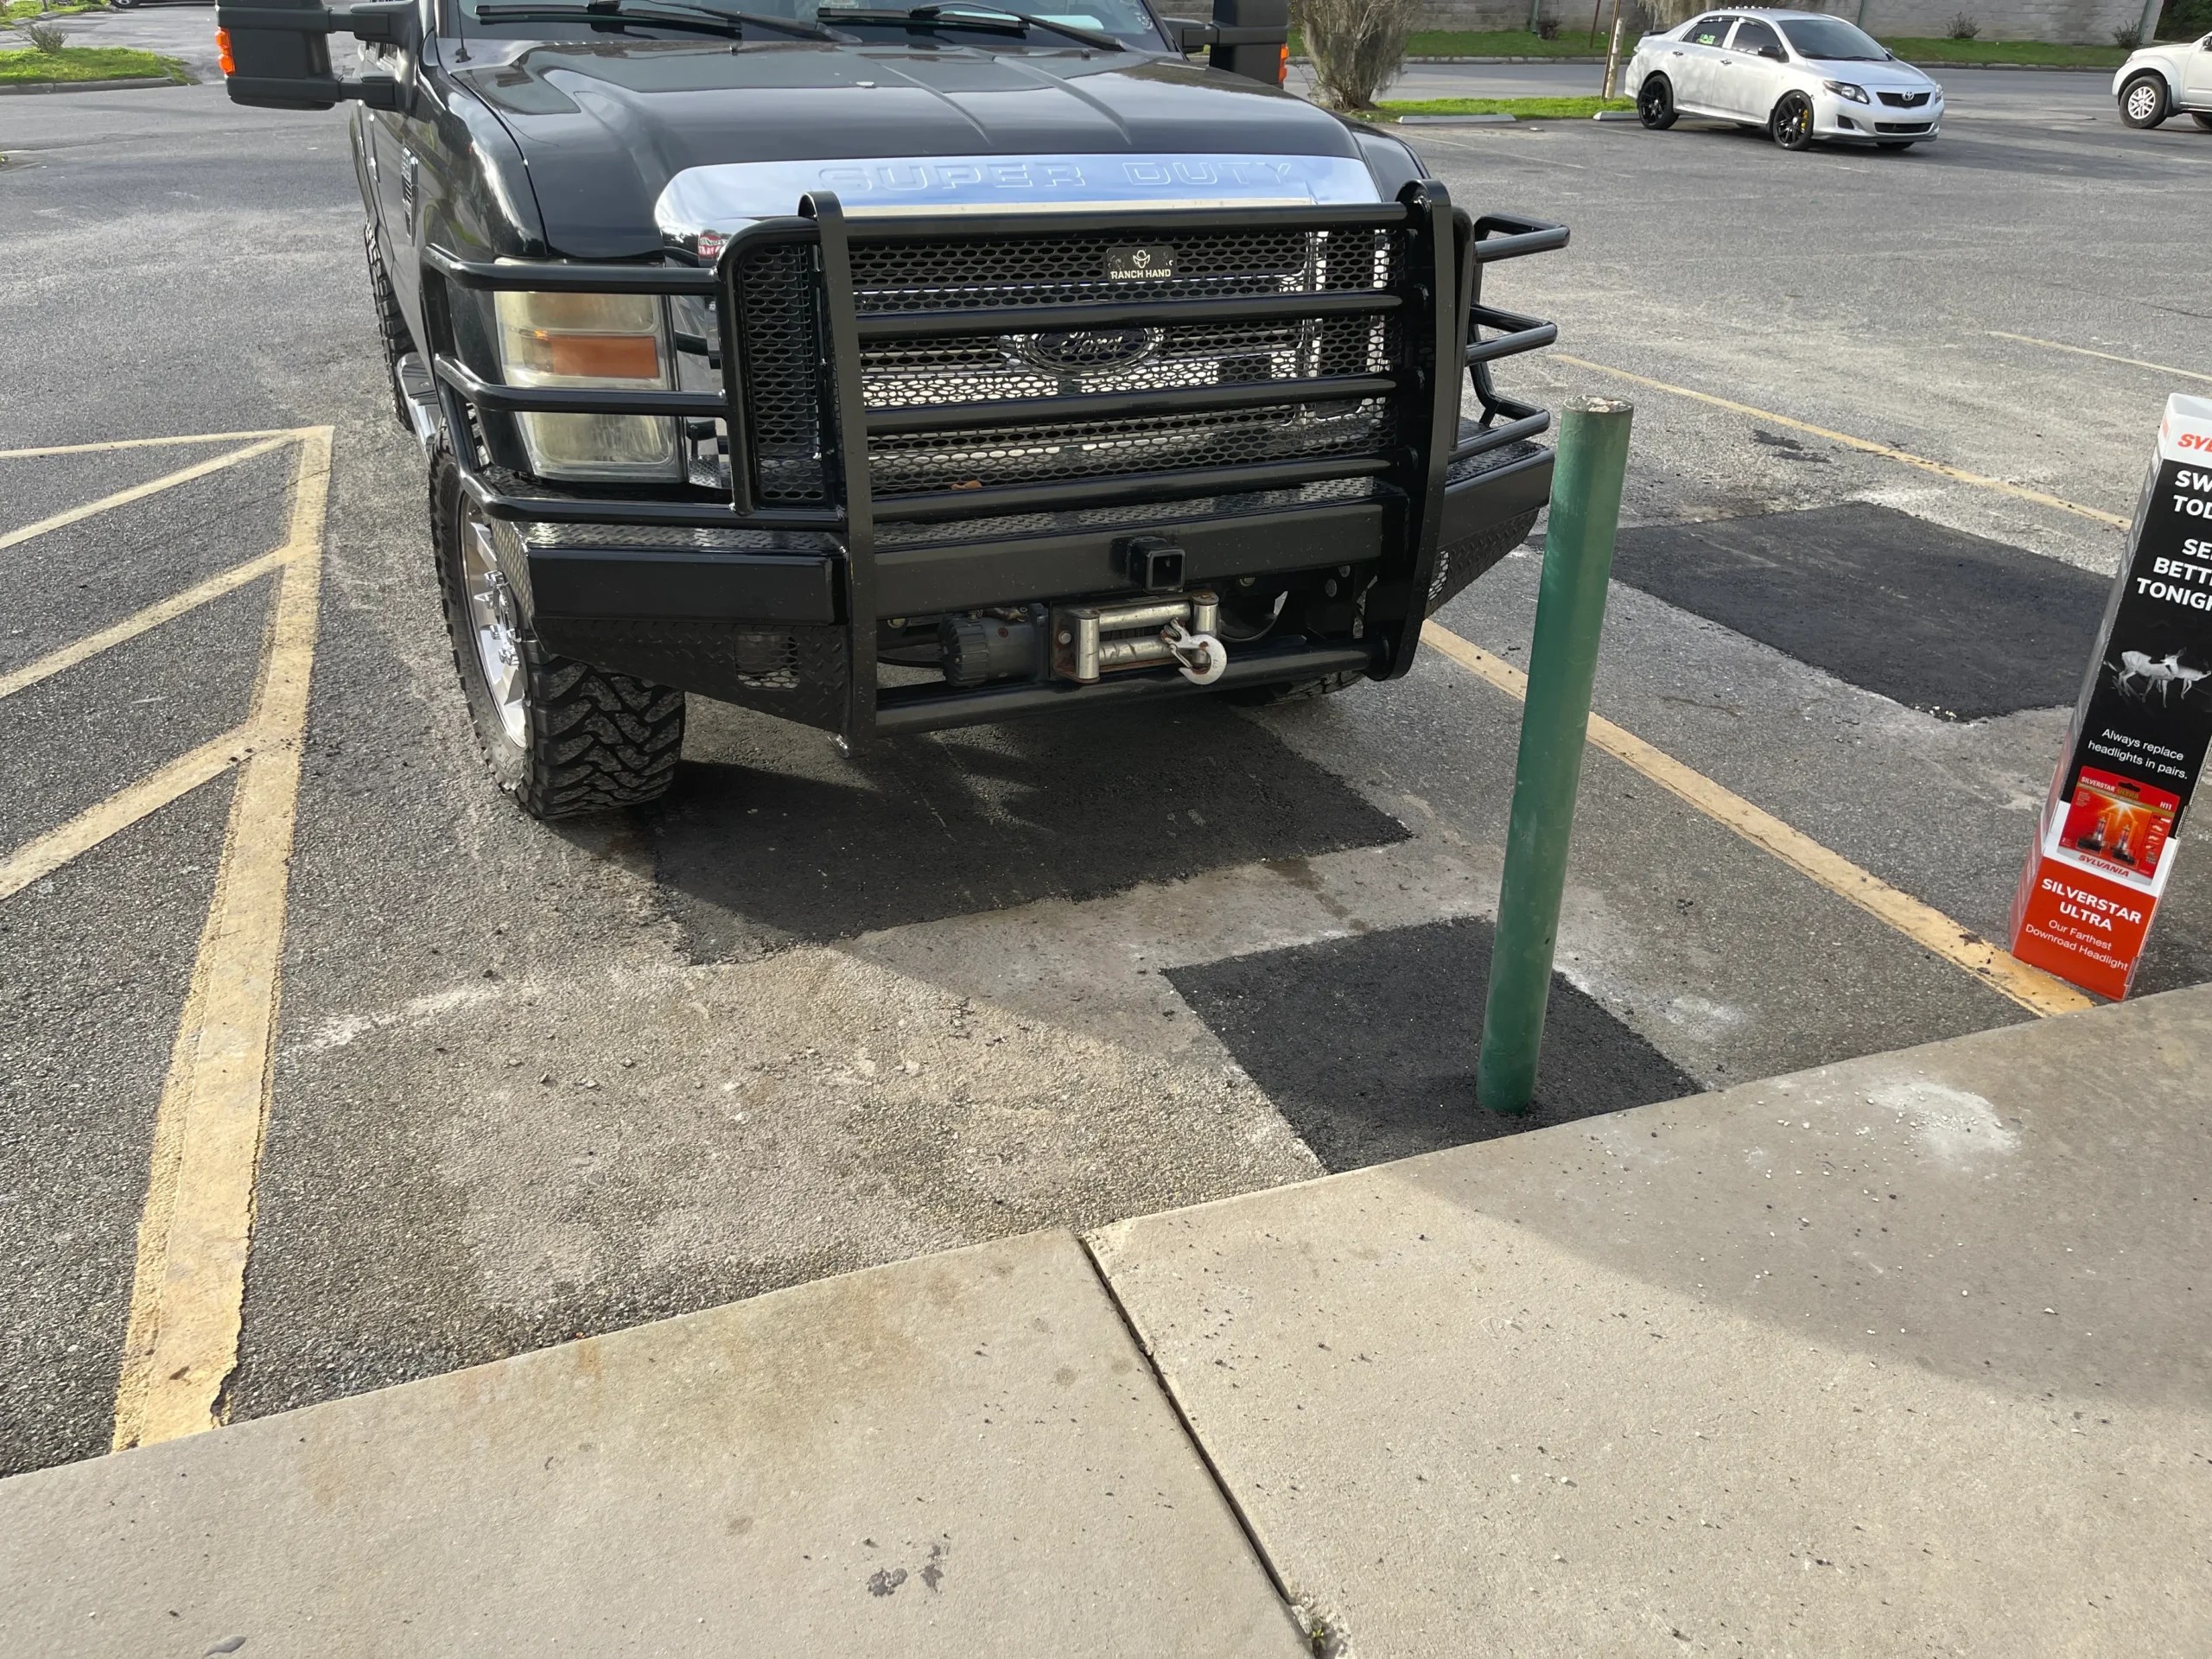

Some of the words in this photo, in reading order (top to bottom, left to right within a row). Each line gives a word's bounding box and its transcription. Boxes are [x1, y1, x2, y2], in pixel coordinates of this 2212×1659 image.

[817, 162, 1086, 191] SUPER
[1122, 162, 1292, 185] DUTY
[1110, 269, 1143, 279] RANCH
[1145, 268, 1172, 278] HAND
[2182, 538, 2212, 560] SE
[2152, 556, 2212, 587] BETT
[2088, 740, 2143, 766] headlights
[2145, 758, 2156, 769] in
[2157, 764, 2188, 779] pairs.
[2101, 728, 2141, 747] Always
[2142, 742, 2184, 761] replace
[2081, 776, 2116, 792] SILVERSTAR
[2077, 855, 2130, 877] SYLVANIA
[2041, 878, 2142, 925] SILVERSTAR
[2059, 901, 2113, 931] ULTRA
[2024, 924, 2077, 951] Downroad
[2078, 944, 2128, 971] Headlight
[2048, 919, 2069, 933] Our
[2069, 927, 2113, 951] Farthest
